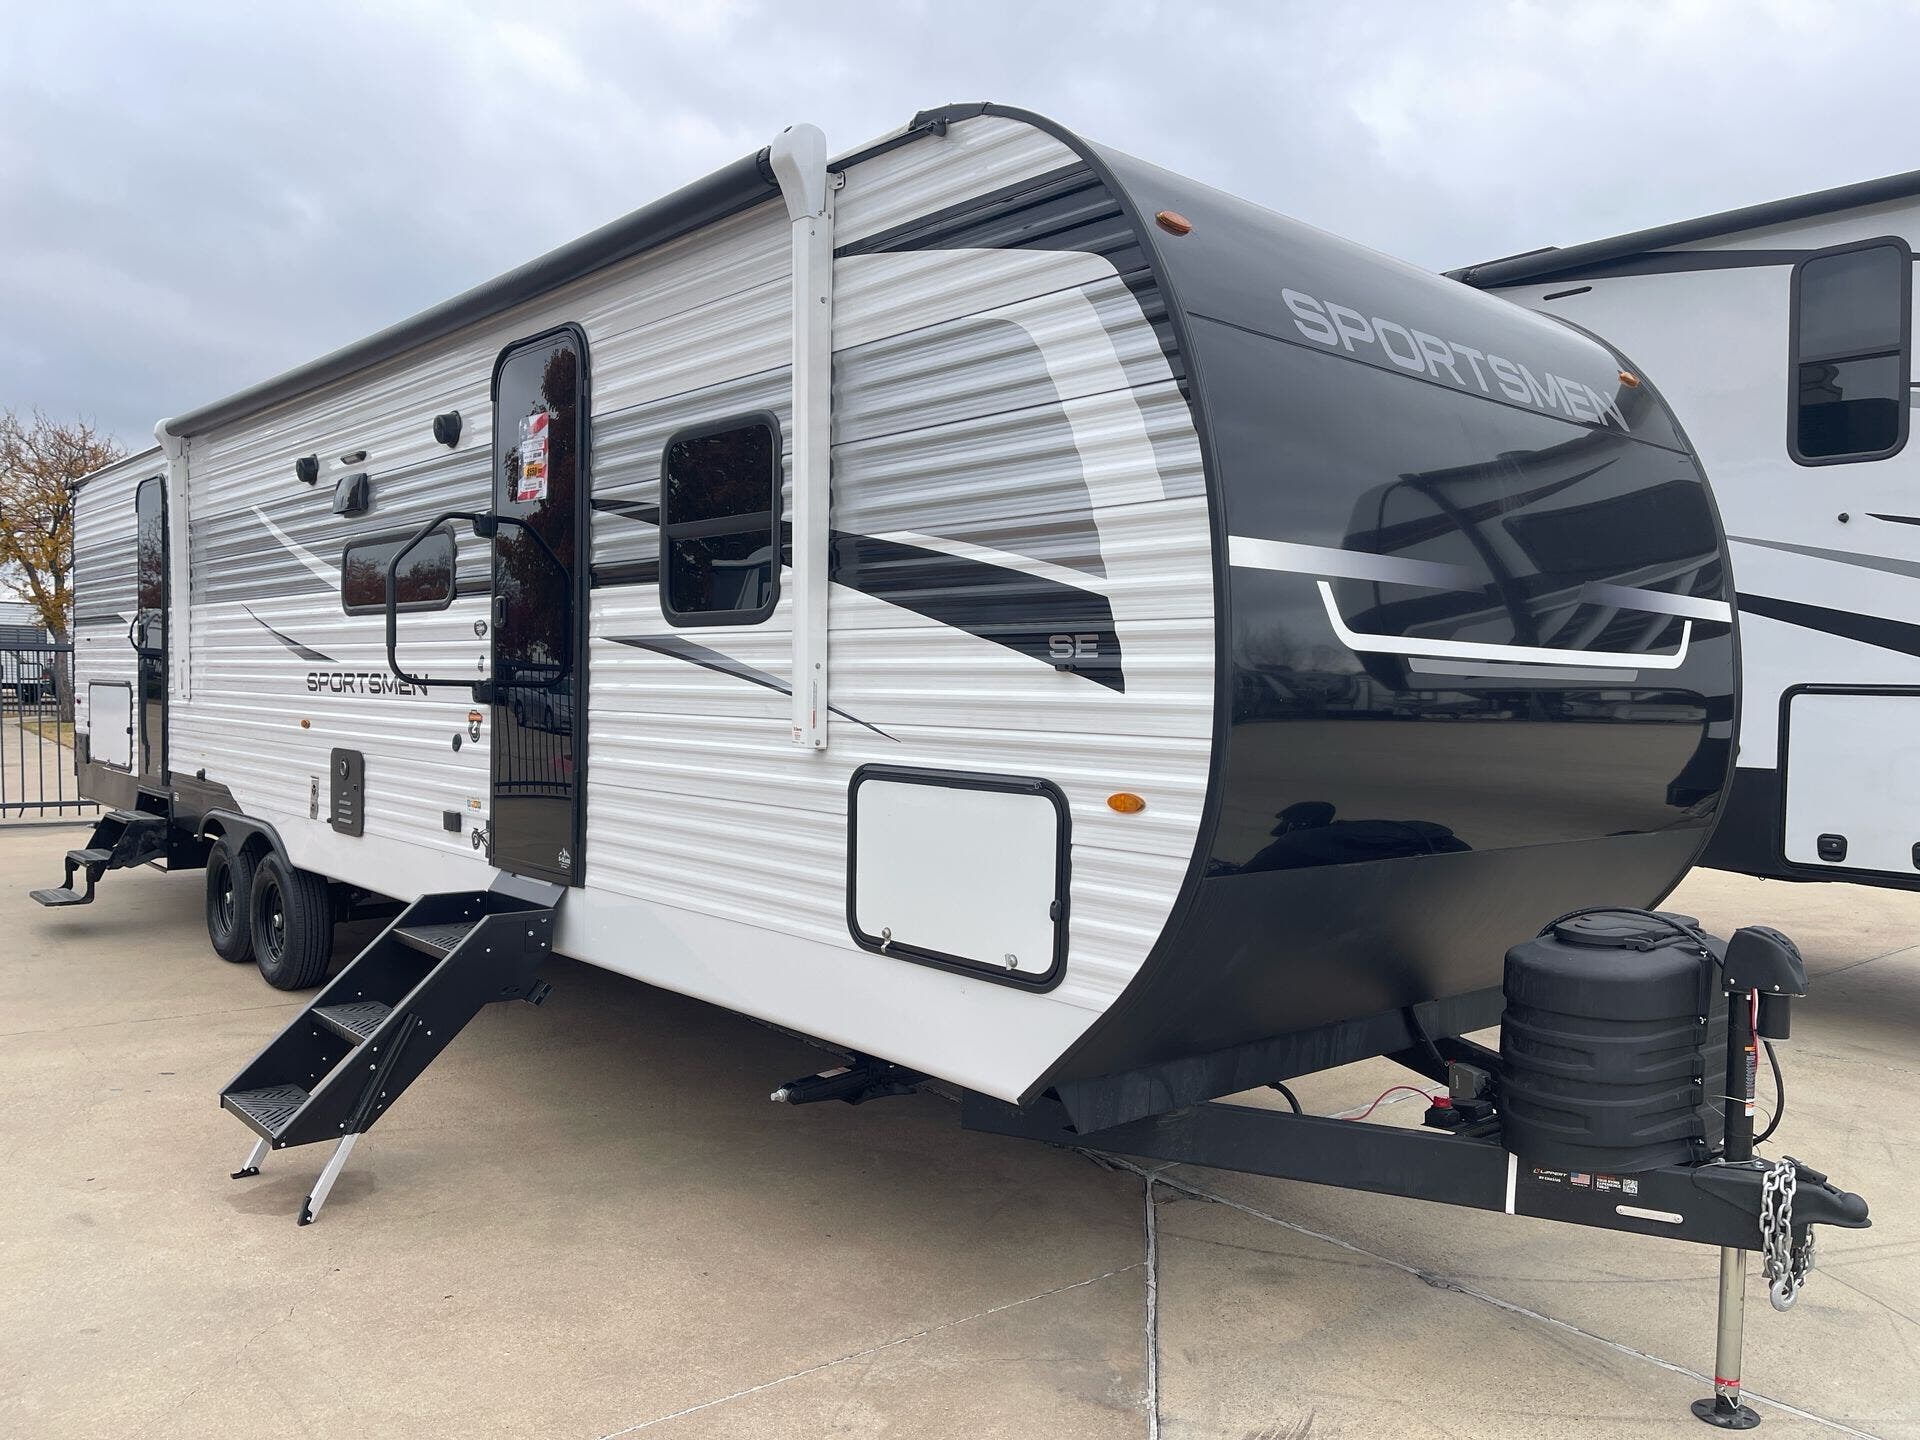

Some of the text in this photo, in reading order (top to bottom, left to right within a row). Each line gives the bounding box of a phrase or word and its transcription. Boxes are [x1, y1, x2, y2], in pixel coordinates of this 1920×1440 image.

[1281, 287, 1630, 432] SPORTSMEN
[1048, 634, 1099, 658] SE
[306, 672, 429, 696] SPORTSMEN
